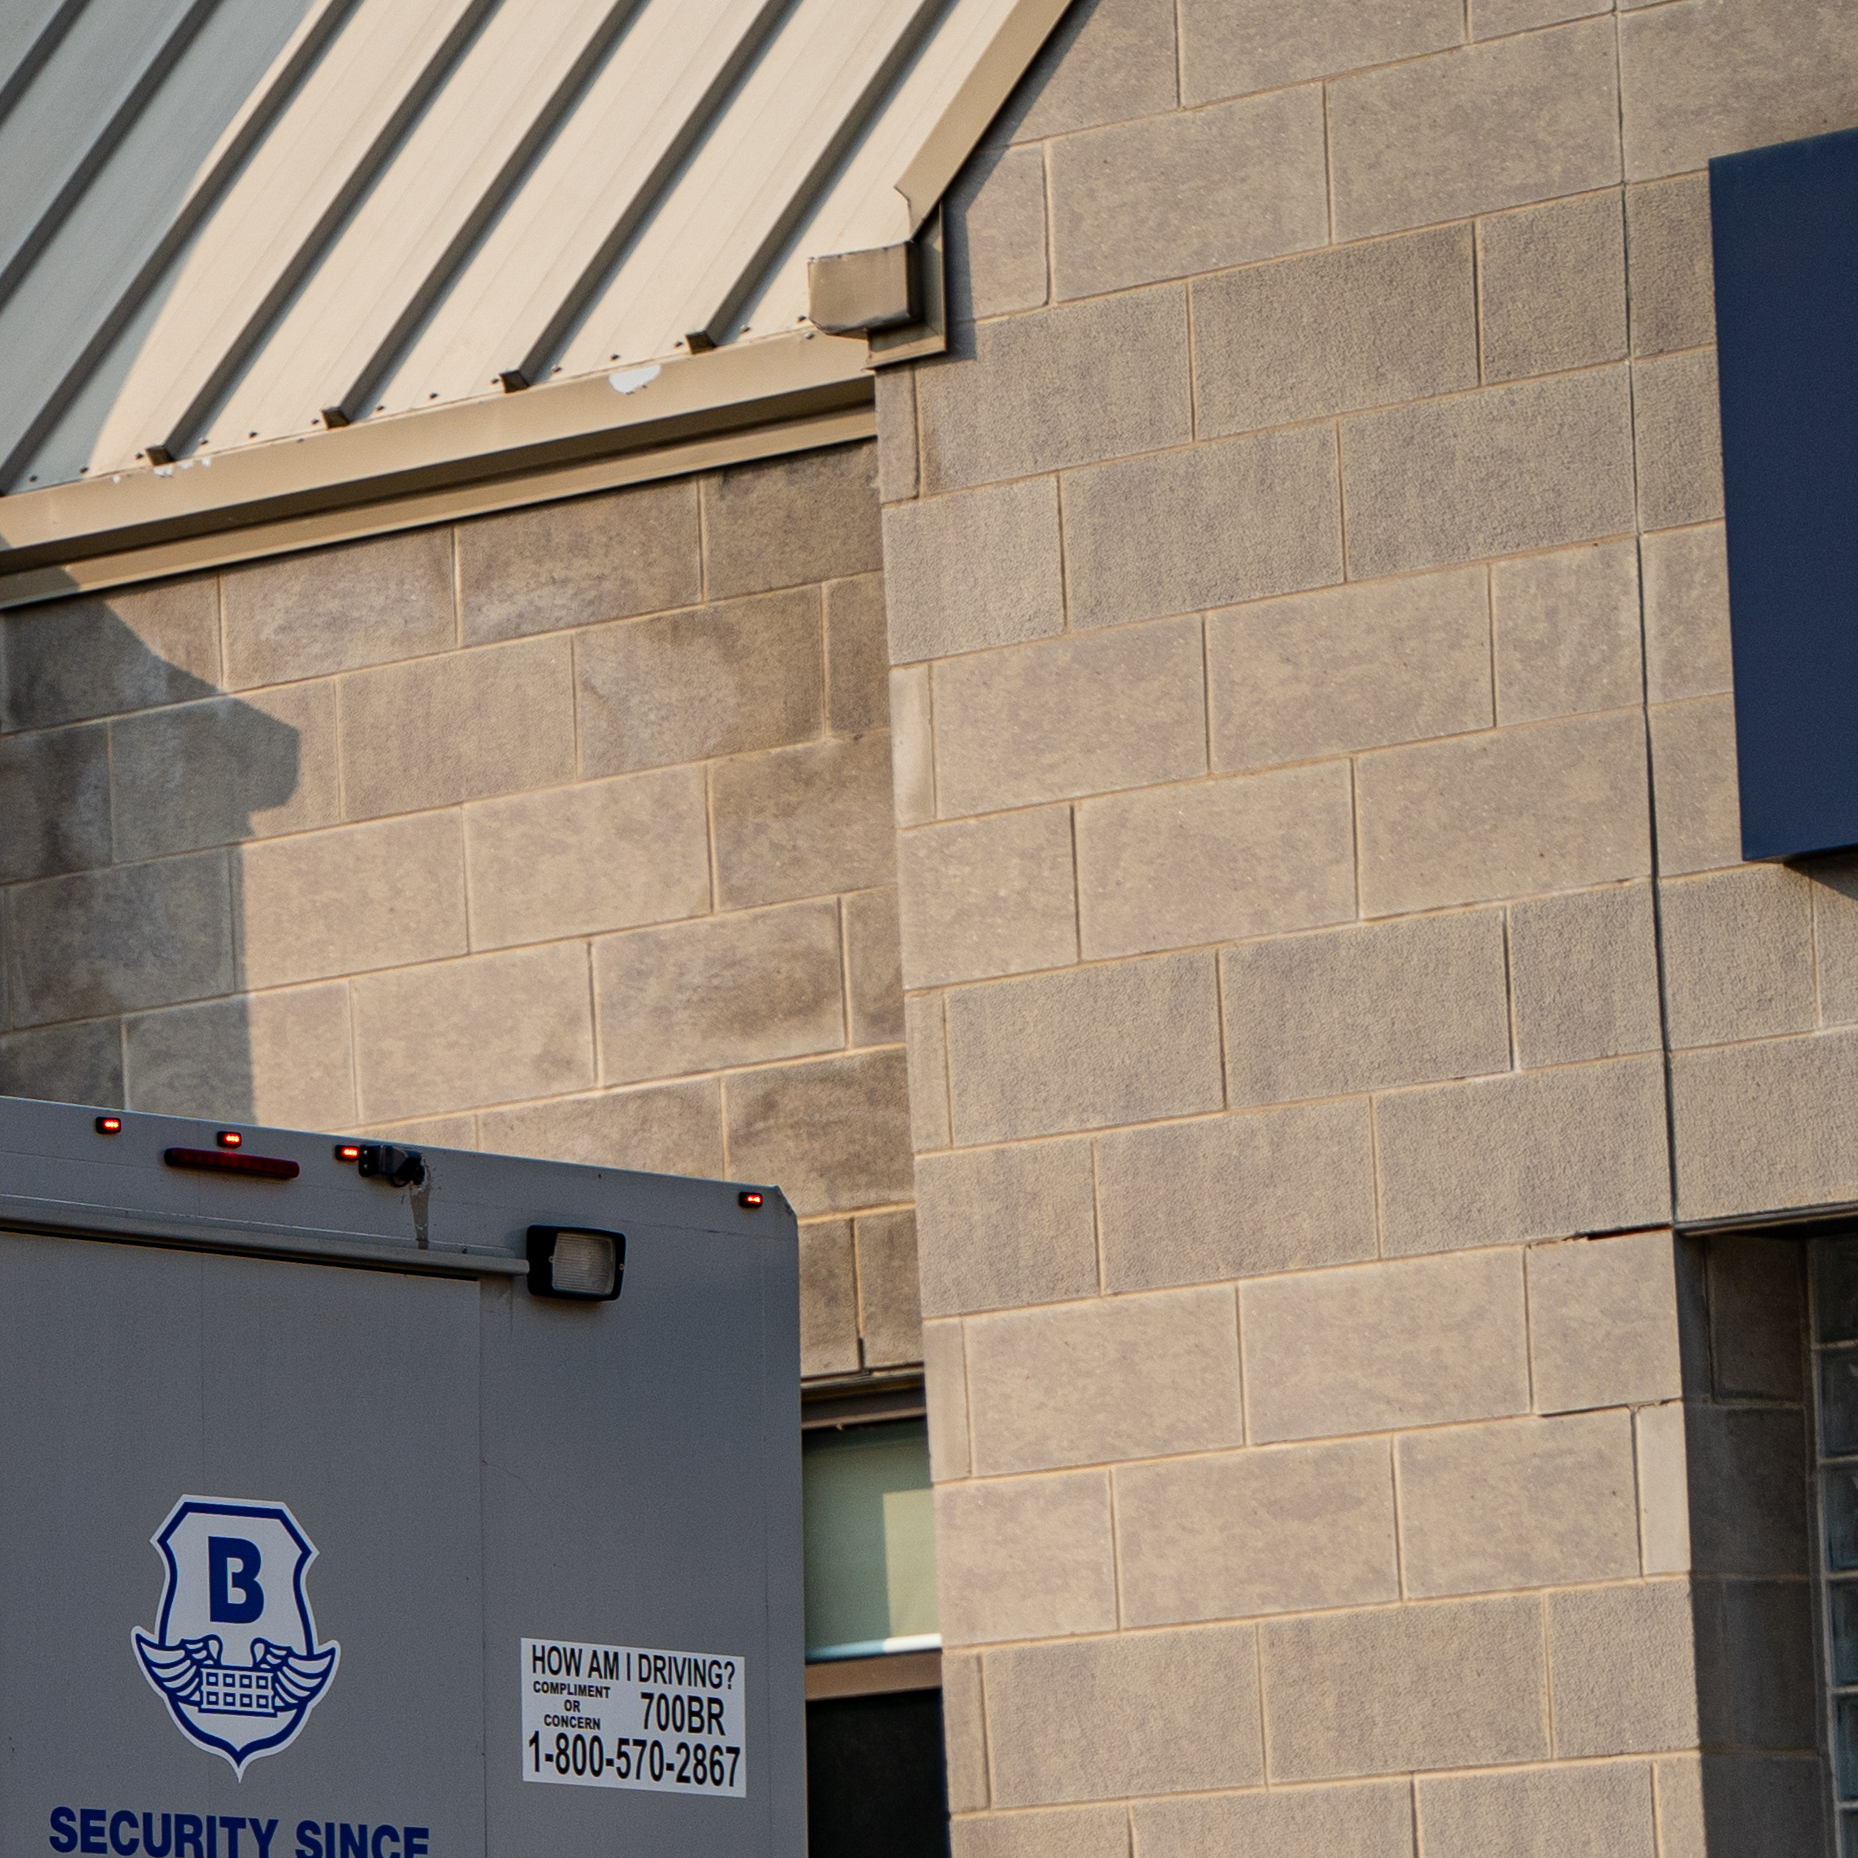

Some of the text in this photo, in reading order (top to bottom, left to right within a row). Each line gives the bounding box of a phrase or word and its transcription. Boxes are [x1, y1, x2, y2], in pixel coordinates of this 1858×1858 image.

[207, 1535, 265, 1625] B
[531, 1643, 736, 1691] HOW AM I DRIVING?
[532, 1680, 611, 1699] COMPLIMENT
[543, 1713, 601, 1731] CONCERN
[563, 1699, 581, 1714] OR
[640, 1691, 726, 1736] 700BR
[528, 1729, 741, 1788] 1-800-570-2867
